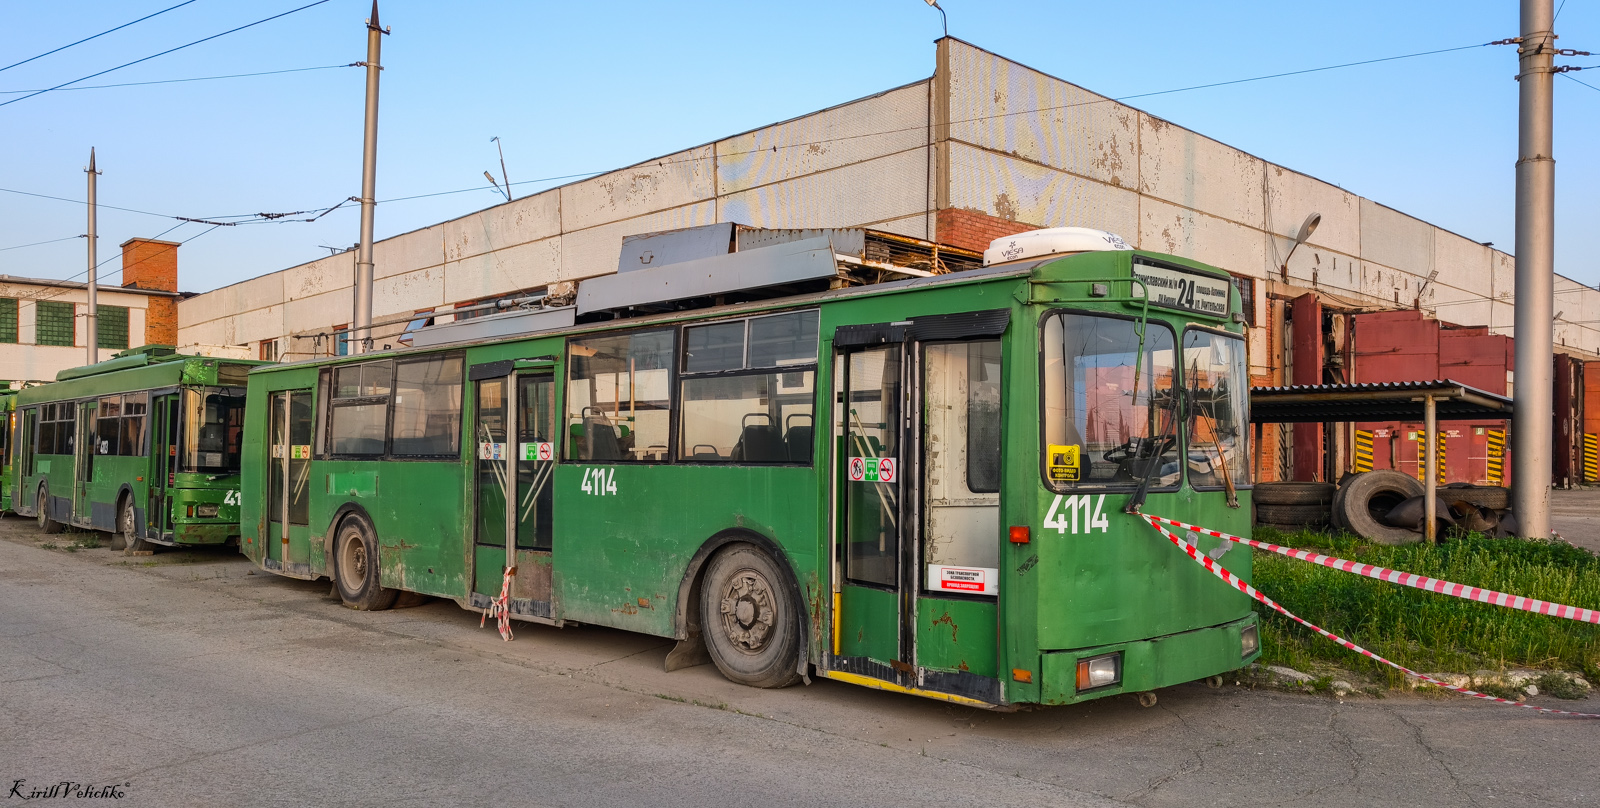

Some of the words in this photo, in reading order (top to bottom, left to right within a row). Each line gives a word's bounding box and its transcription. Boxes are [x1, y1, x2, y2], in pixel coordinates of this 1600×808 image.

[1001, 247, 1024, 257] VIESA
[1177, 278, 1195, 308] 24
[1201, 298, 1225, 313] Учительская
[581, 467, 617, 496] 4114
[1043, 494, 1109, 534] 4114
